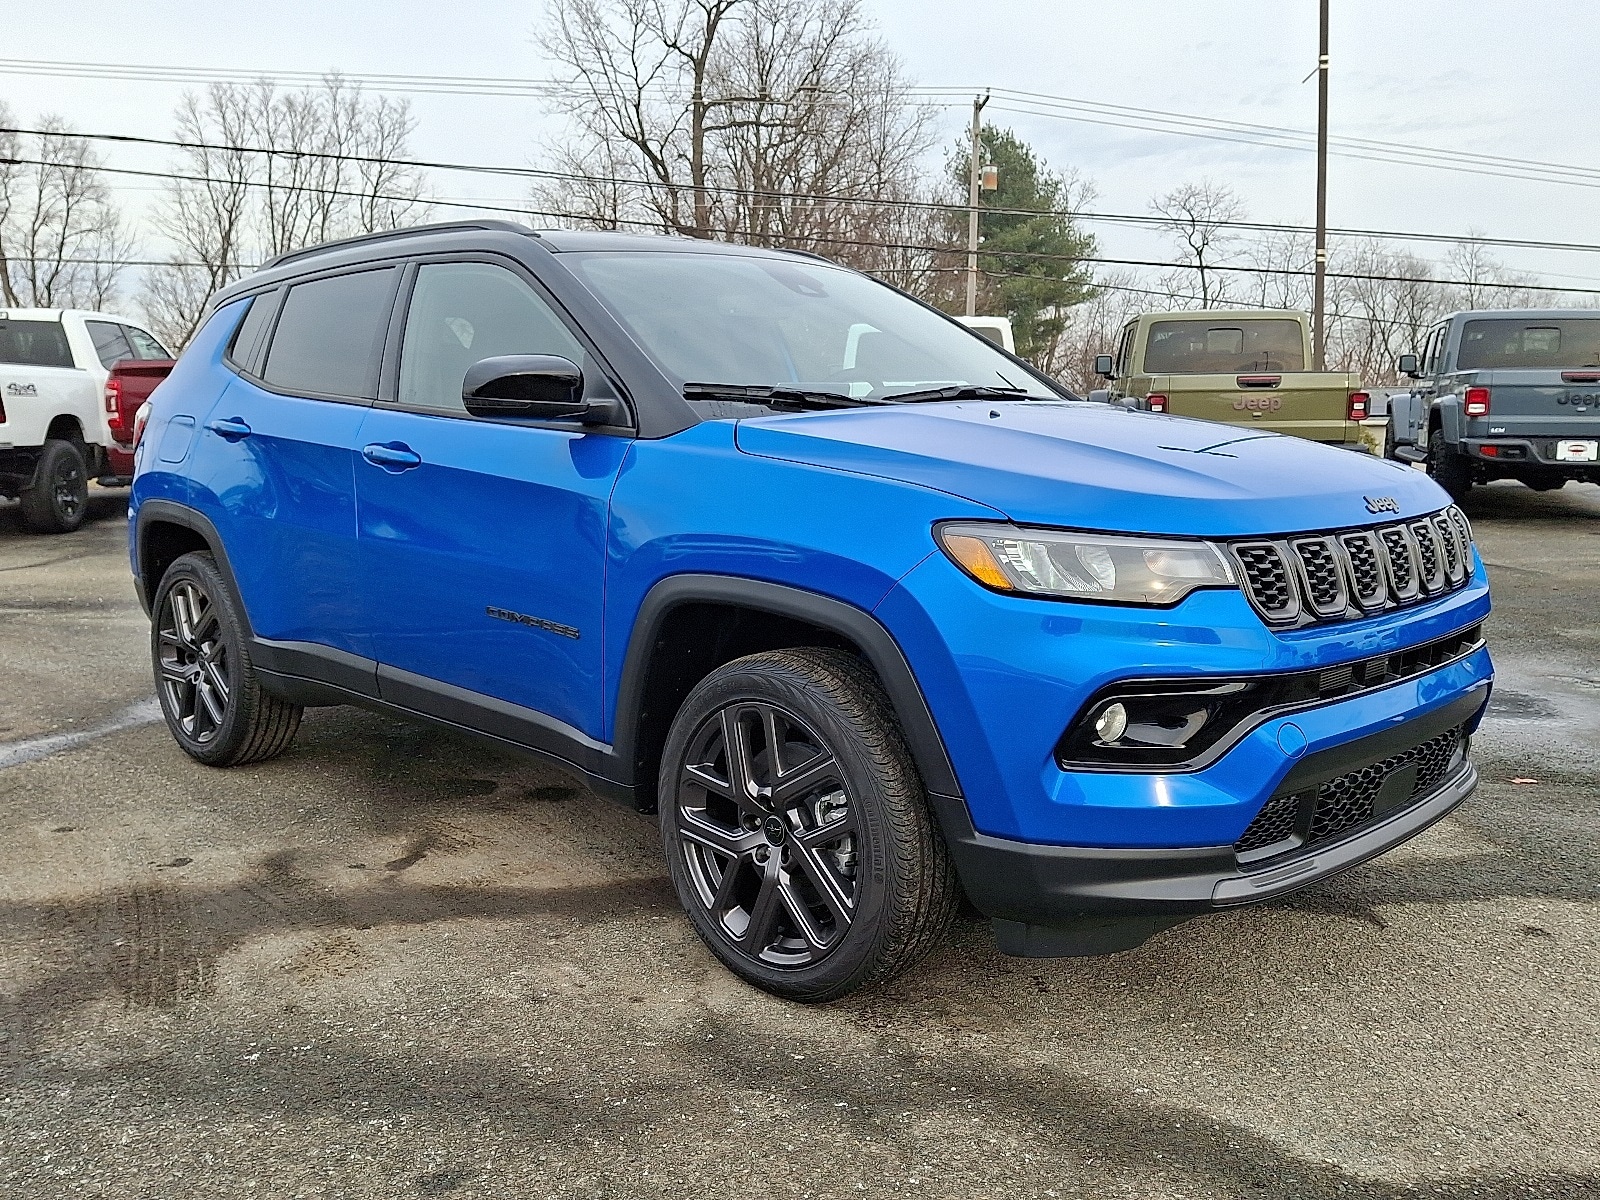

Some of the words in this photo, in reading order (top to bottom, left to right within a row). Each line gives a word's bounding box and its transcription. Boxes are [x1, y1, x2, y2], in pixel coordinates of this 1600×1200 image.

[1233, 395, 1282, 413] Jeep
[1362, 495, 1400, 515] Jeep
[486, 605, 580, 640] COMPASS
